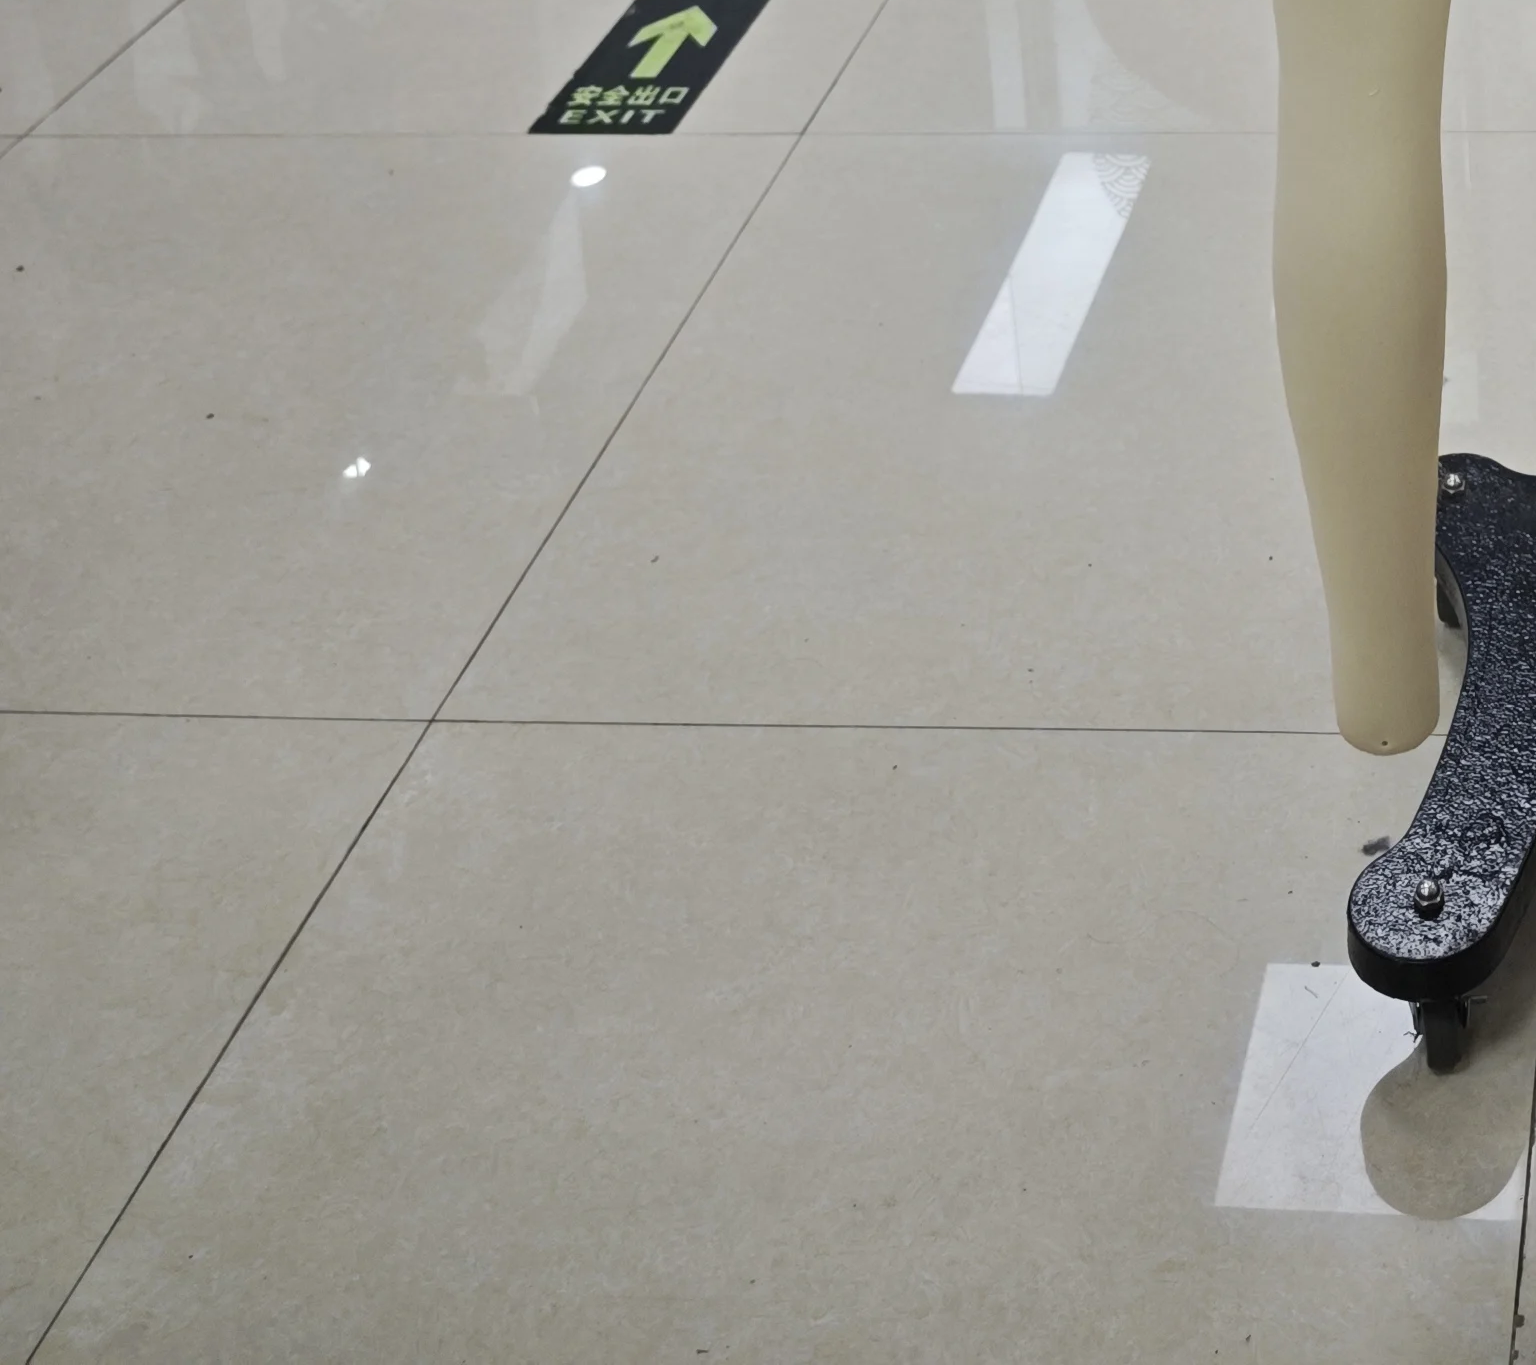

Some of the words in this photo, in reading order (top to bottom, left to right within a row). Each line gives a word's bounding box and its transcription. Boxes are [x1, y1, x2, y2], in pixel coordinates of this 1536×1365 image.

[567, 85, 690, 106] 安全出口
[558, 109, 666, 125] EXIT
